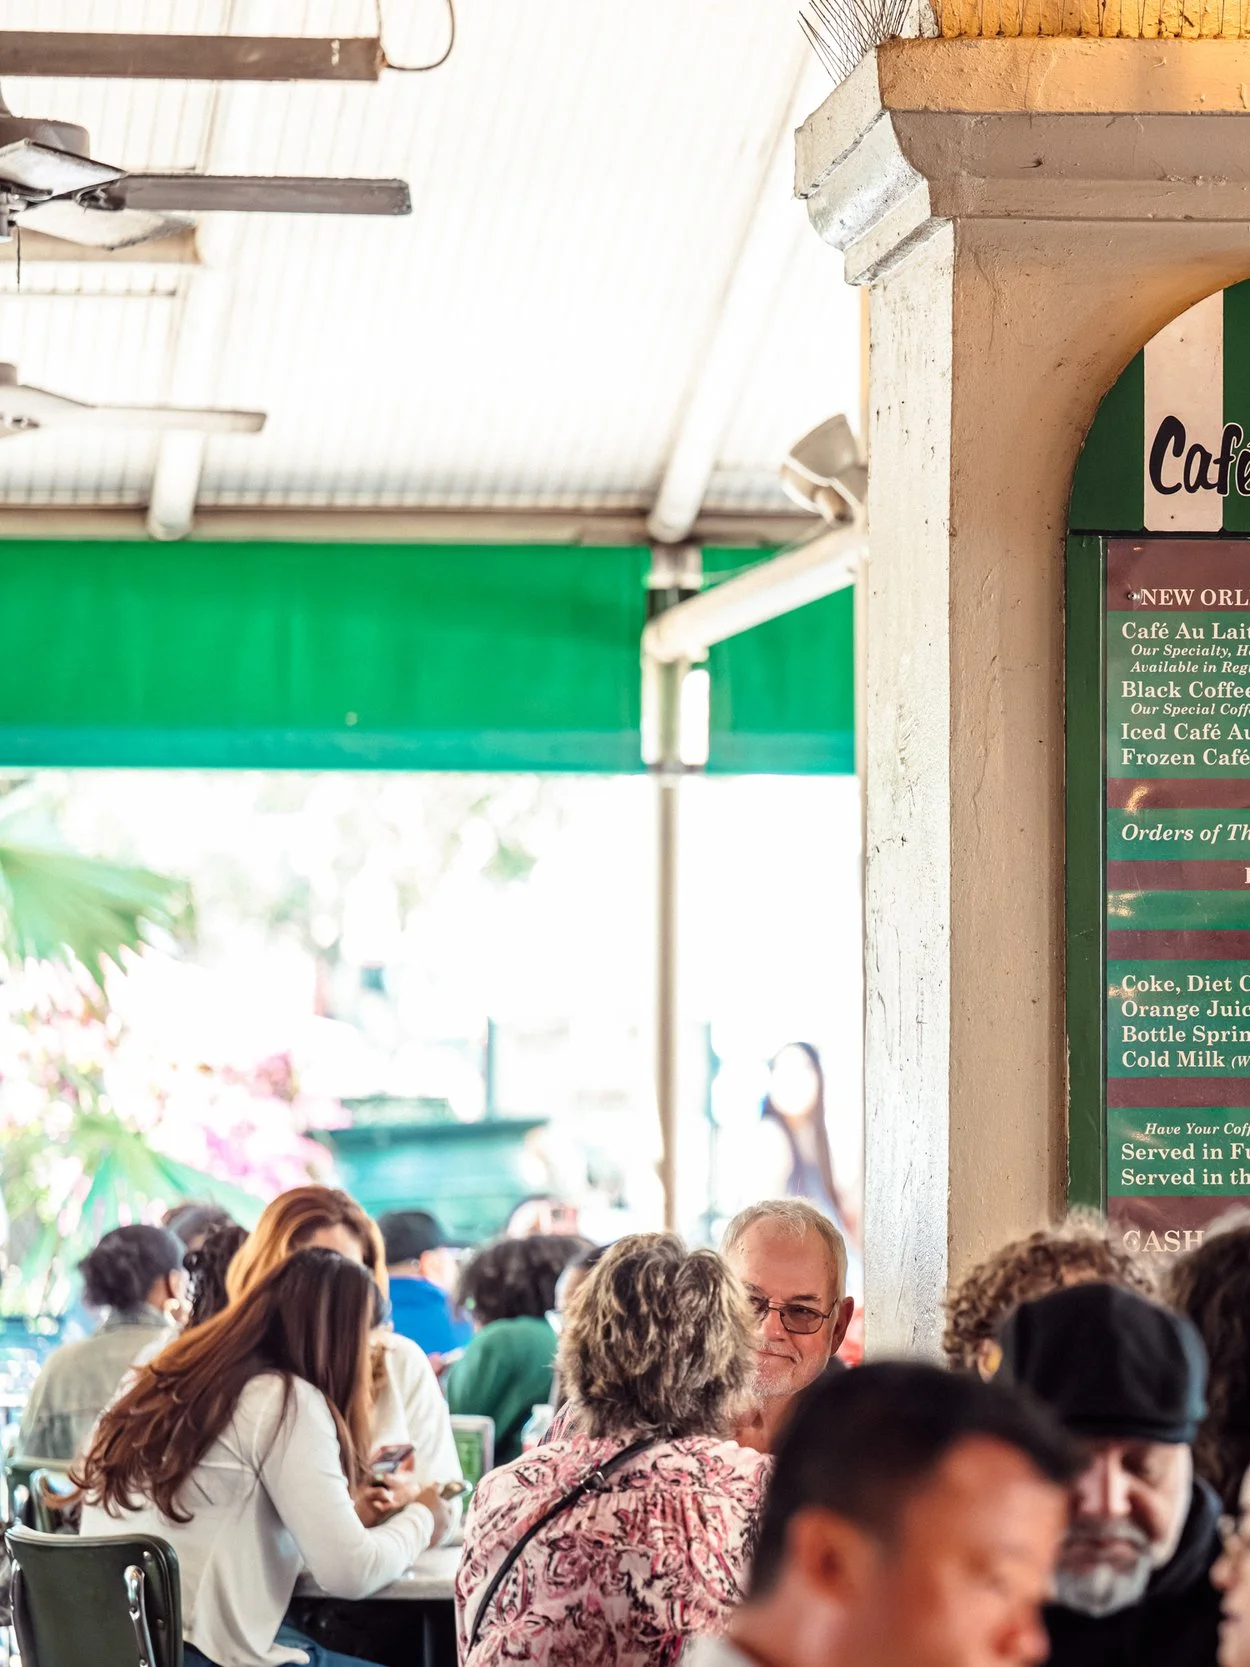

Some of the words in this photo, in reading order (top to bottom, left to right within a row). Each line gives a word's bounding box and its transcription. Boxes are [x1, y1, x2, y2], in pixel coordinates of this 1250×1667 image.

[1140, 589, 1196, 607] NEW
[1121, 621, 1169, 640] Café
[1175, 624, 1205, 640] Au
[1130, 645, 1160, 657] Our
[1163, 644, 1232, 660] Specialty,
[1130, 661, 1199, 674] Available
[1202, 661, 1218, 674] in
[1121, 681, 1182, 698] Black
[1130, 704, 1159, 715] Our
[1163, 703, 1215, 718] Special
[1121, 724, 1166, 741] Iced
[1173, 723, 1221, 741] Café
[1121, 749, 1195, 766] Frozen
[1202, 748, 1250, 766] Café
[1121, 824, 1194, 842] Orders
[1200, 823, 1222, 845] of
[1121, 974, 1181, 996] Coke,
[1187, 975, 1233, 993] Diet
[1121, 1000, 1200, 1021] Orange
[1121, 1026, 1186, 1043] Bottle
[1121, 1051, 1171, 1069] Cold
[1176, 1051, 1225, 1069] Milk
[1144, 1123, 1181, 1135] Have
[1185, 1123, 1219, 1135] Your
[1121, 1143, 1196, 1161] Served
[1202, 1143, 1224, 1160] in
[1121, 1168, 1196, 1186] Served
[1202, 1168, 1224, 1185] in
